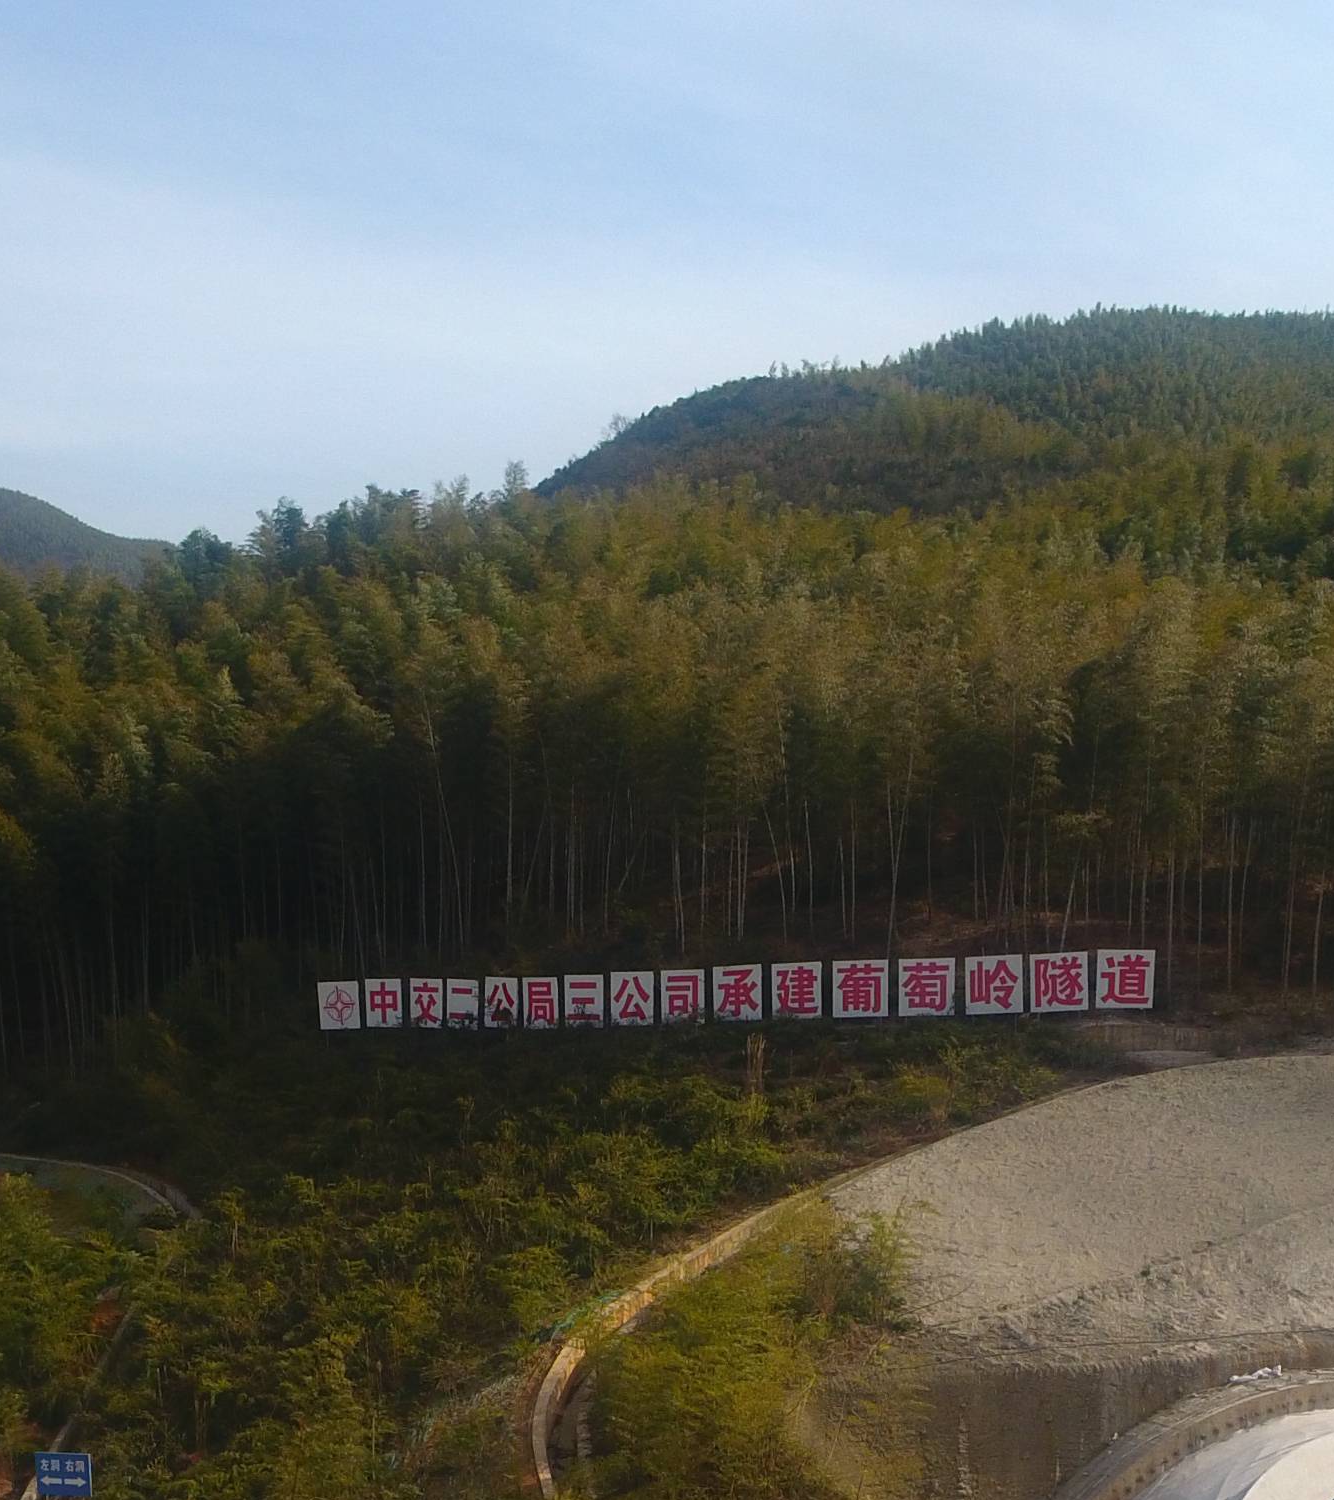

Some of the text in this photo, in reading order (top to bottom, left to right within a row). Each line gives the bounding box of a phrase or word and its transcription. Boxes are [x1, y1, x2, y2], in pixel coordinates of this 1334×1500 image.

[368, 957, 1152, 1024] 中交二公局三公司承建葡萄岭隧道
